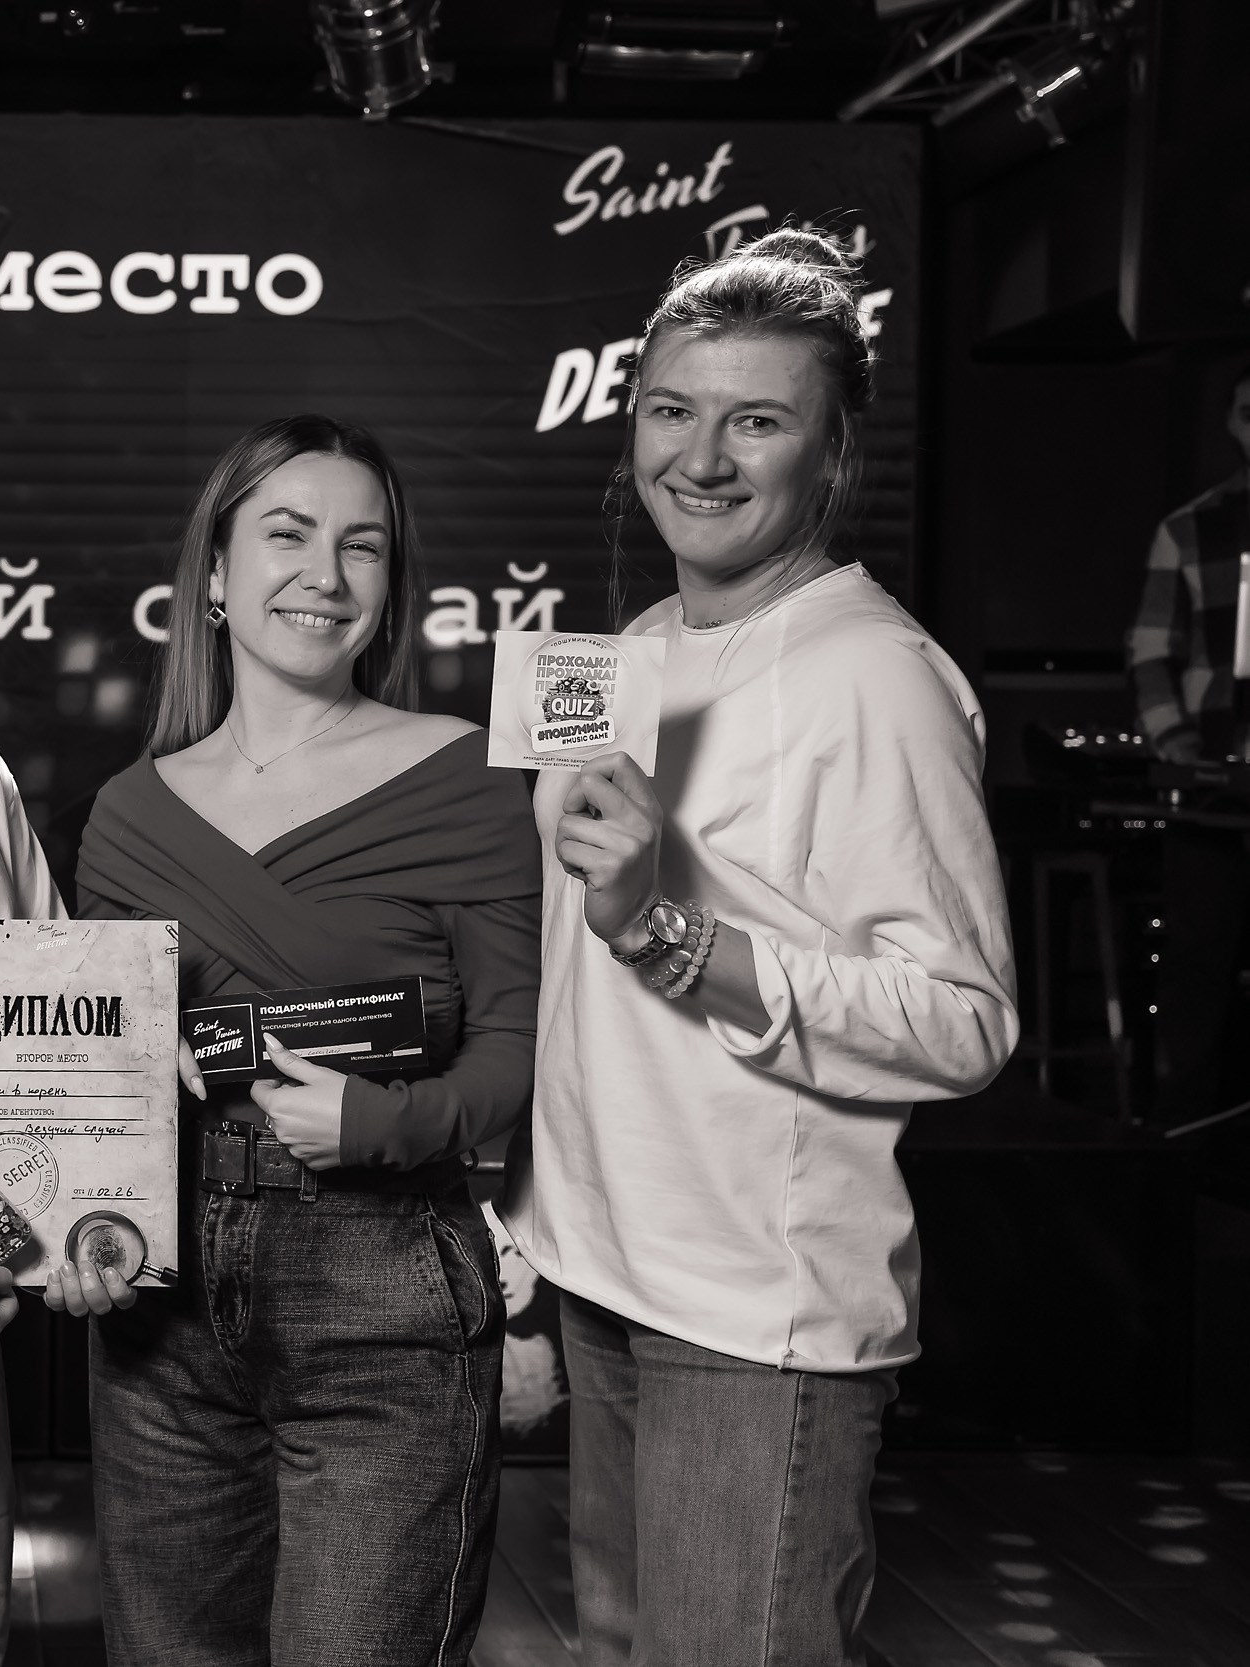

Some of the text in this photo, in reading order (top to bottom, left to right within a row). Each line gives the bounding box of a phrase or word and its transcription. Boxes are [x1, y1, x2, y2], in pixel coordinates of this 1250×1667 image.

[554, 141, 733, 236] Saint
[537, 654, 618, 669] ПРОХОДКА!
[536, 667, 617, 681] ПРОХОДКА!
[551, 697, 595, 716] QUIZ
[537, 720, 610, 741] #ПОШУМИМ?
[562, 732, 609, 745] #MUSIC GAME
[260, 992, 406, 1016] ПОДАРОЧНЫЙ СЕРТИФИКАТ
[193, 1019, 219, 1036] Saint
[261, 1012, 393, 1031] Бесплатная игра для одного детектива
[215, 1027, 242, 1040] Twins
[194, 1037, 245, 1060] DETECTIVE
[16, 1053, 89, 1064] ВТОРОЕ МЕСТО
[10, 1108, 55, 1117] АГЕНТСТВО:
[2, 1149, 50, 1187] SECRET
[33, 1169, 54, 1209] CLASSIFIED
